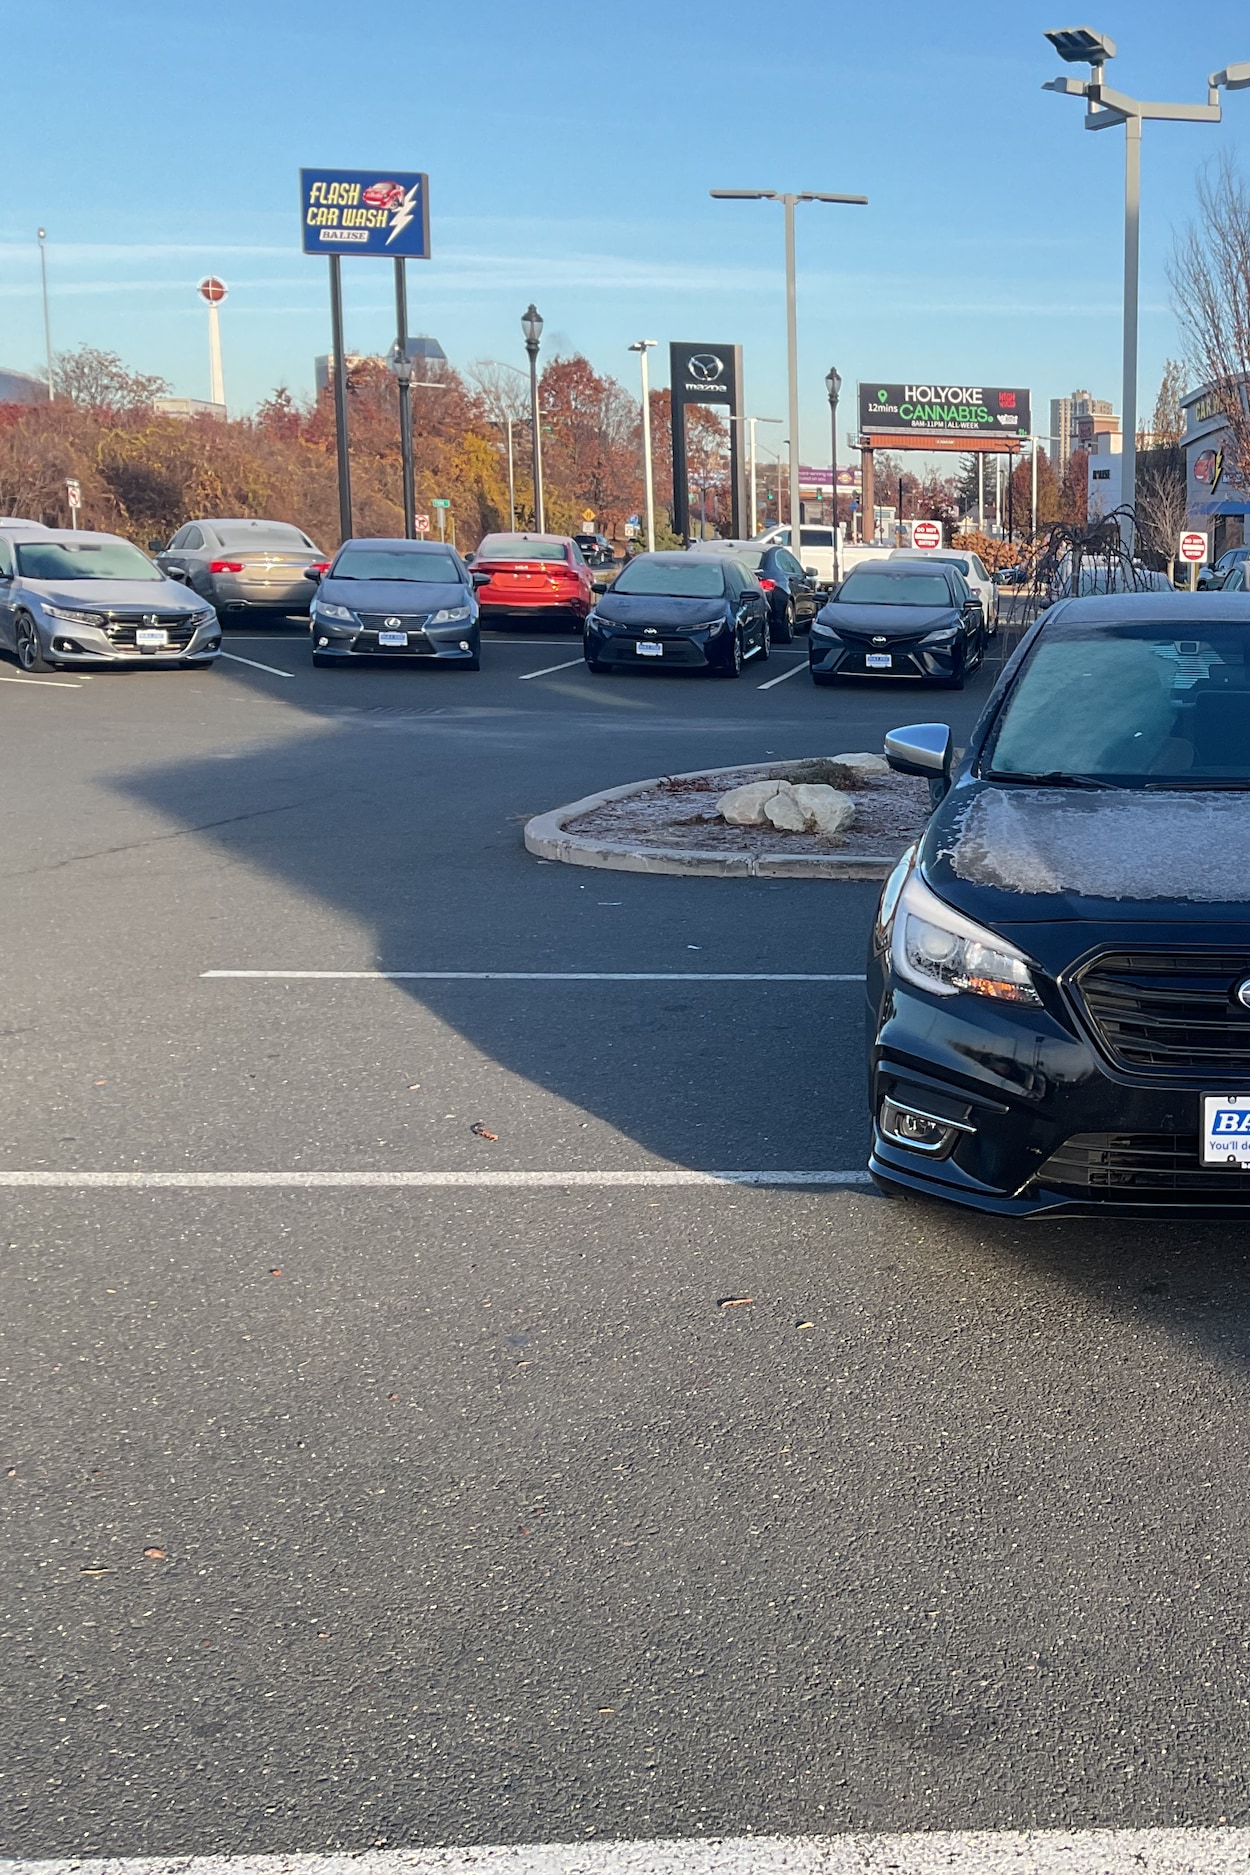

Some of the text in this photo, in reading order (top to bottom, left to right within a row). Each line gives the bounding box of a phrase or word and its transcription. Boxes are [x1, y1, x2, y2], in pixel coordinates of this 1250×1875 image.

[309, 182, 361, 206] FLASH
[306, 207, 389, 228] CAR WASH
[321, 231, 367, 240] BALISE
[685, 383, 728, 393] mazda
[905, 385, 983, 405] HOLYOKE
[868, 403, 898, 413] 12mins
[1195, 395, 1212, 421] CAR
[947, 422, 979, 430] ALL-WEEK
[1209, 1141, 1238, 1151] You'll
